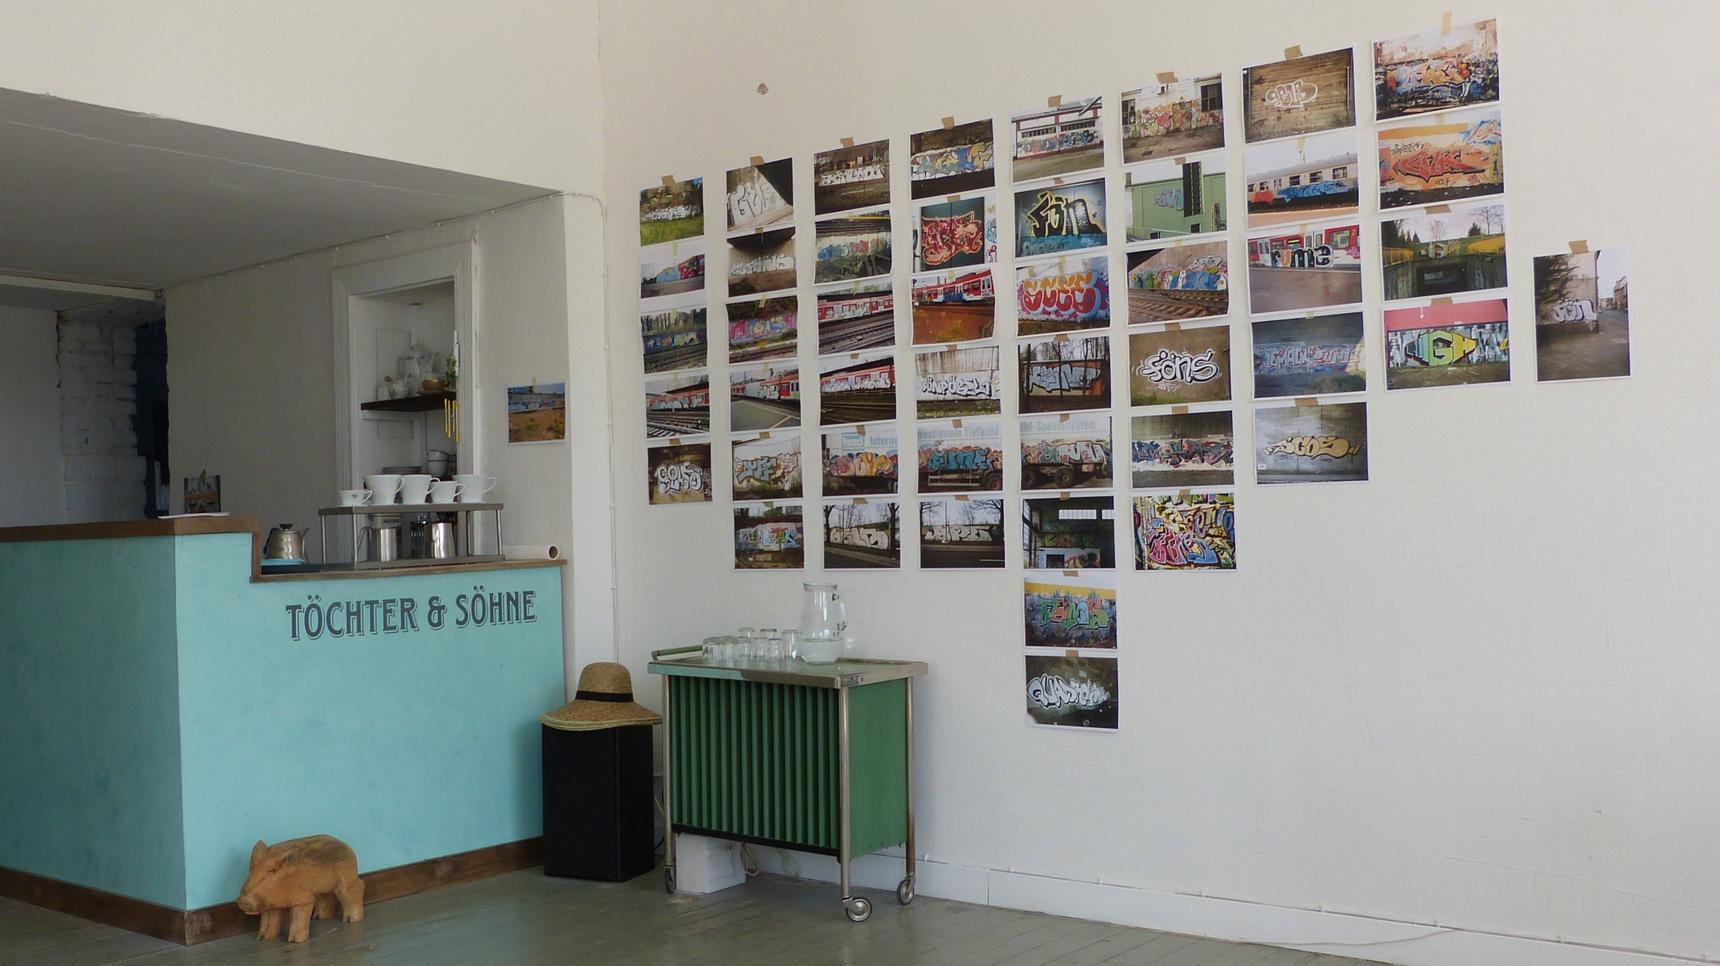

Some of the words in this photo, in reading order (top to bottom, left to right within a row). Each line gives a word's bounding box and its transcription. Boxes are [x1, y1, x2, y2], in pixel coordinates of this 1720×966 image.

[285, 594, 420, 641] TÖCHTER
[427, 595, 447, 630] &
[455, 585, 537, 628] SÖHNE
